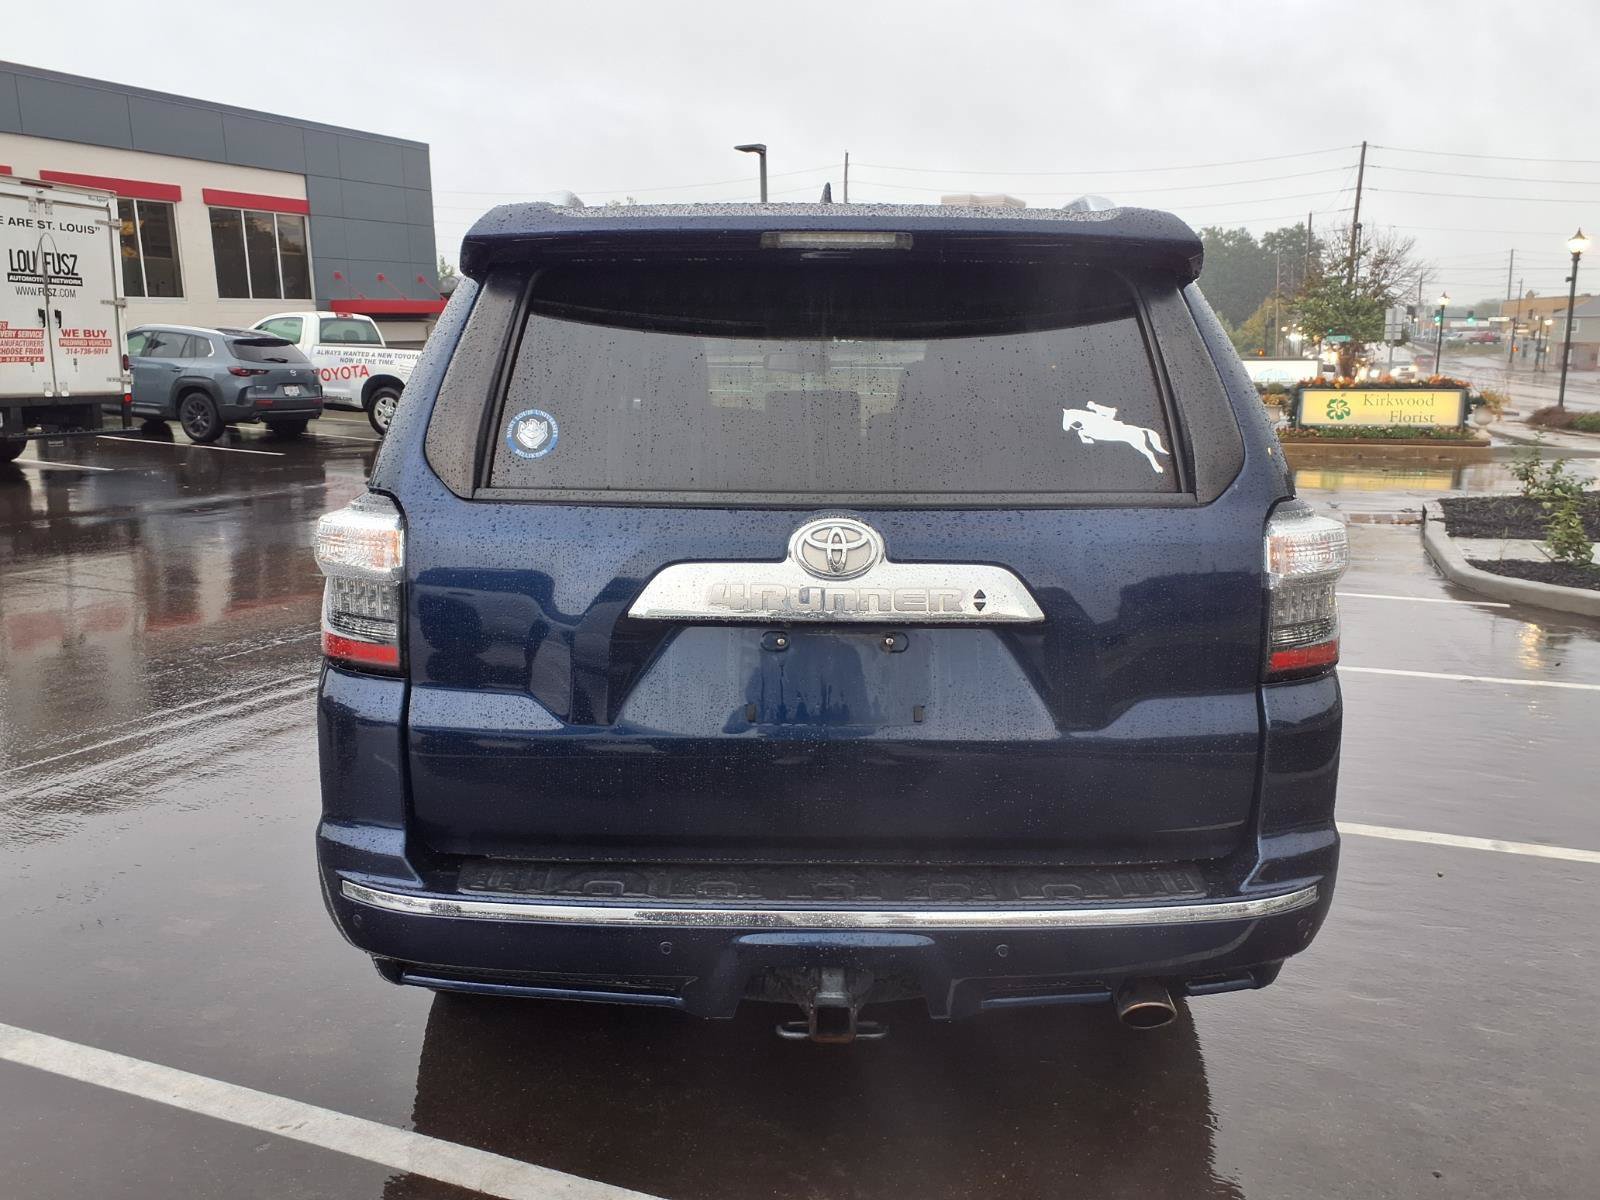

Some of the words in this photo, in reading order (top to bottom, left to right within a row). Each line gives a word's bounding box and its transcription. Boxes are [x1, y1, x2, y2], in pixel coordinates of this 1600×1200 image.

[8, 217, 34, 228] ARE
[37, 220, 55, 230] ST.
[9, 248, 36, 273] LOU
[44, 252, 79, 276] FUSZ
[51, 277, 82, 285] NETWORK
[18, 330, 44, 338] SERVICE
[61, 329, 80, 337] WE
[83, 330, 107, 338] BUY
[343, 350, 370, 358] WANTED
[1363, 393, 1435, 407] Kirkwood
[1390, 410, 1435, 423] Florist
[708, 582, 965, 613] 4RUNNER
